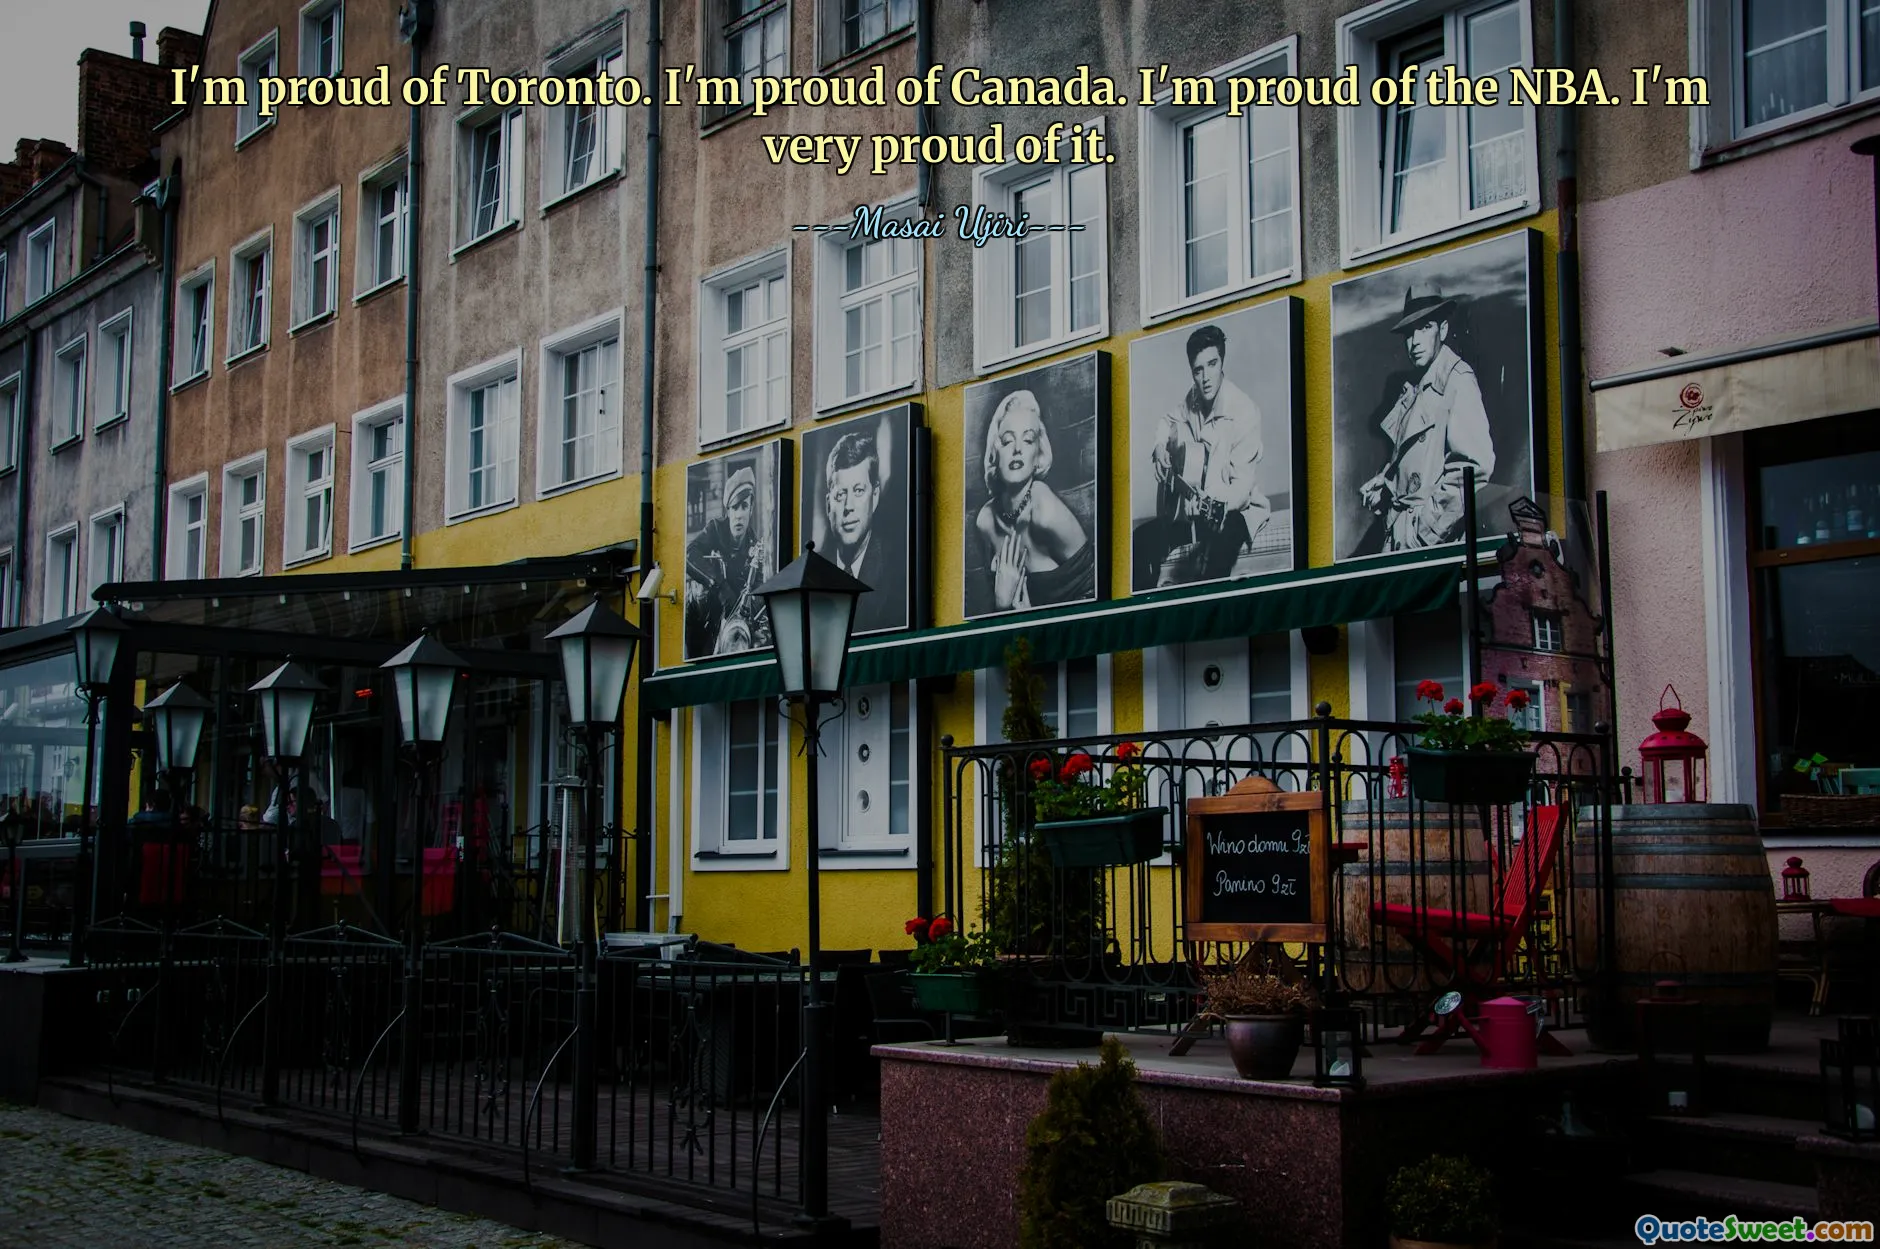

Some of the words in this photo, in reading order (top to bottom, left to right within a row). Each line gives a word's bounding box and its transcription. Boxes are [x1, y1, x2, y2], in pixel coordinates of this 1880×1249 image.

[1207, 831, 1245, 855] Wino
[1248, 834, 1289, 853] domu
[1213, 870, 1265, 896] Panino
